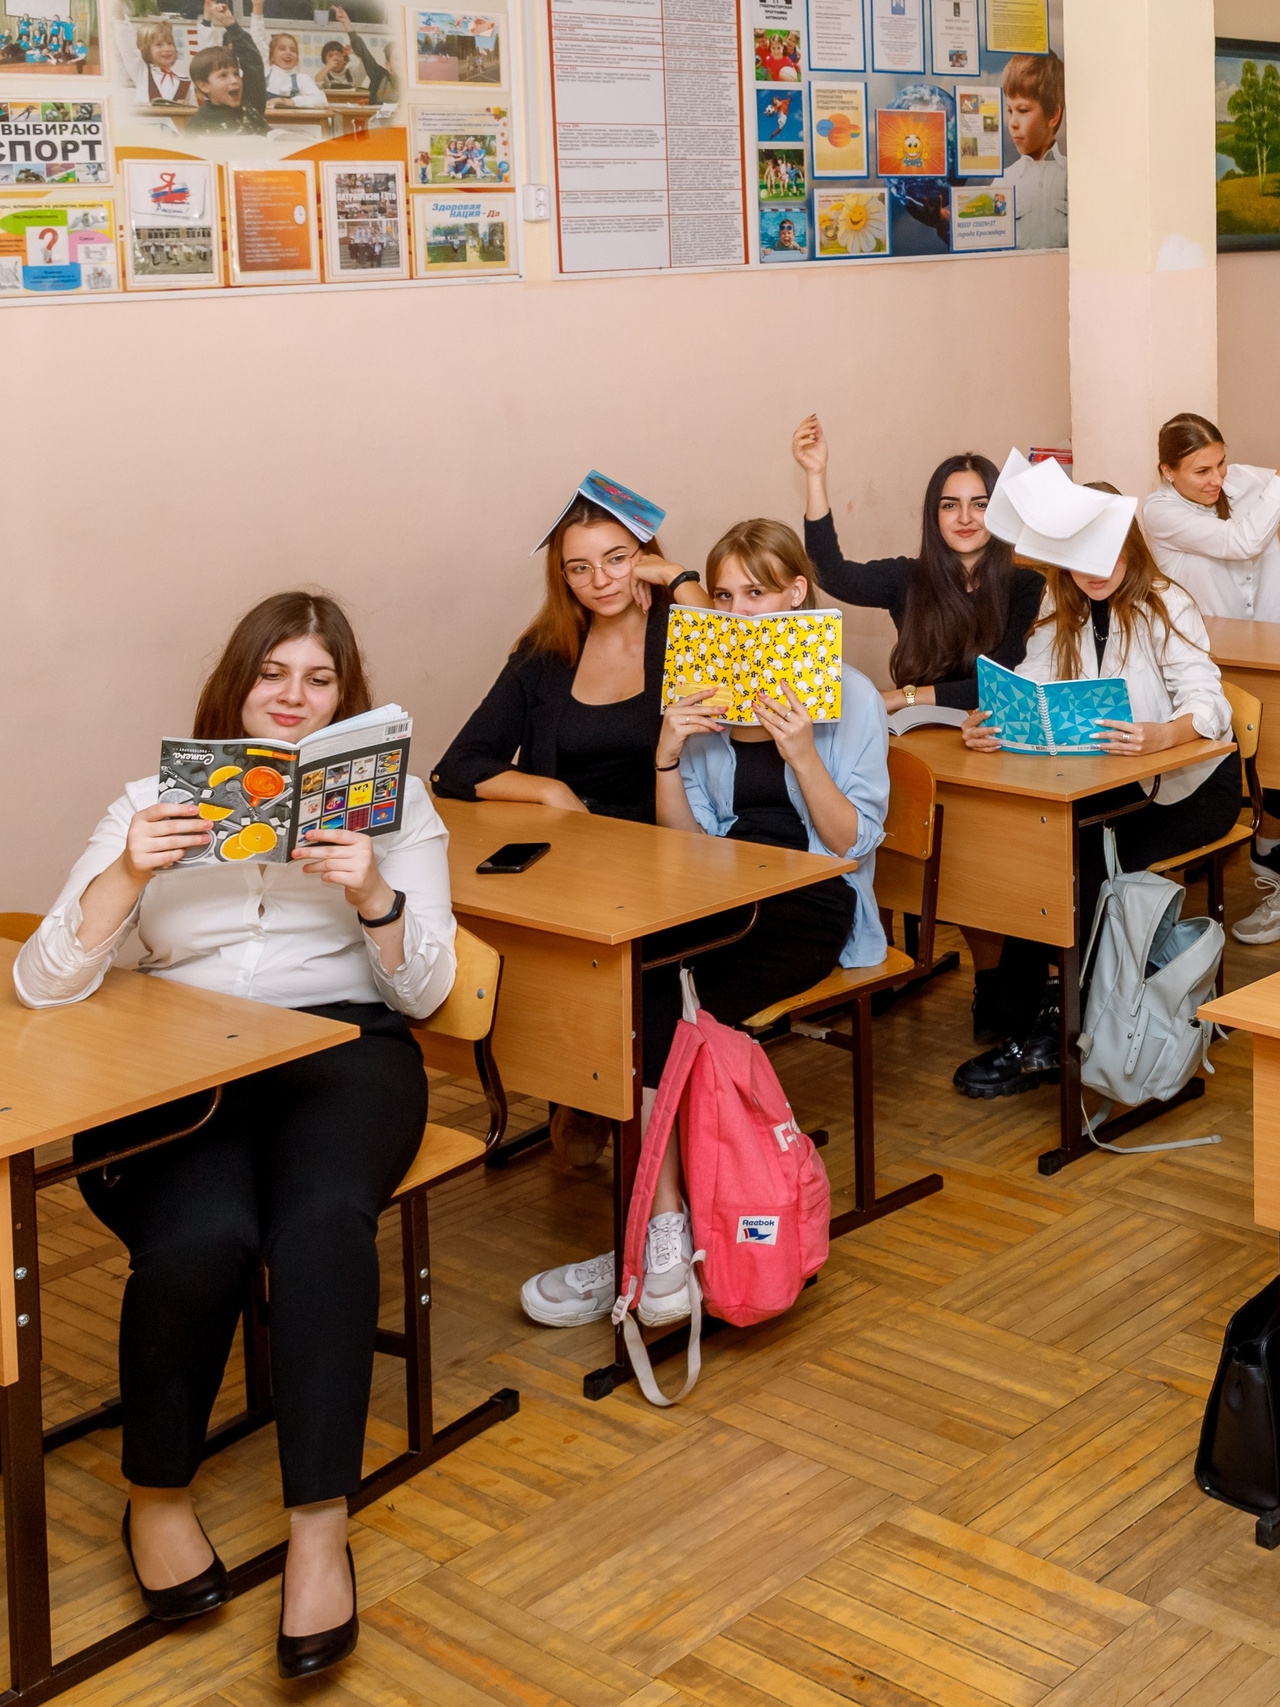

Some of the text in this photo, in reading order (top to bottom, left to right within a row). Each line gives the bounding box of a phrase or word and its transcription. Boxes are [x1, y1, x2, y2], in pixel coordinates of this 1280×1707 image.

[1, 124, 100, 135] ВЫБИРАЮ
[432, 203, 481, 212] Здоровая
[487, 210, 500, 218] Да
[172, 752, 215, 766] Camera
[742, 1219, 775, 1227] Reebok
